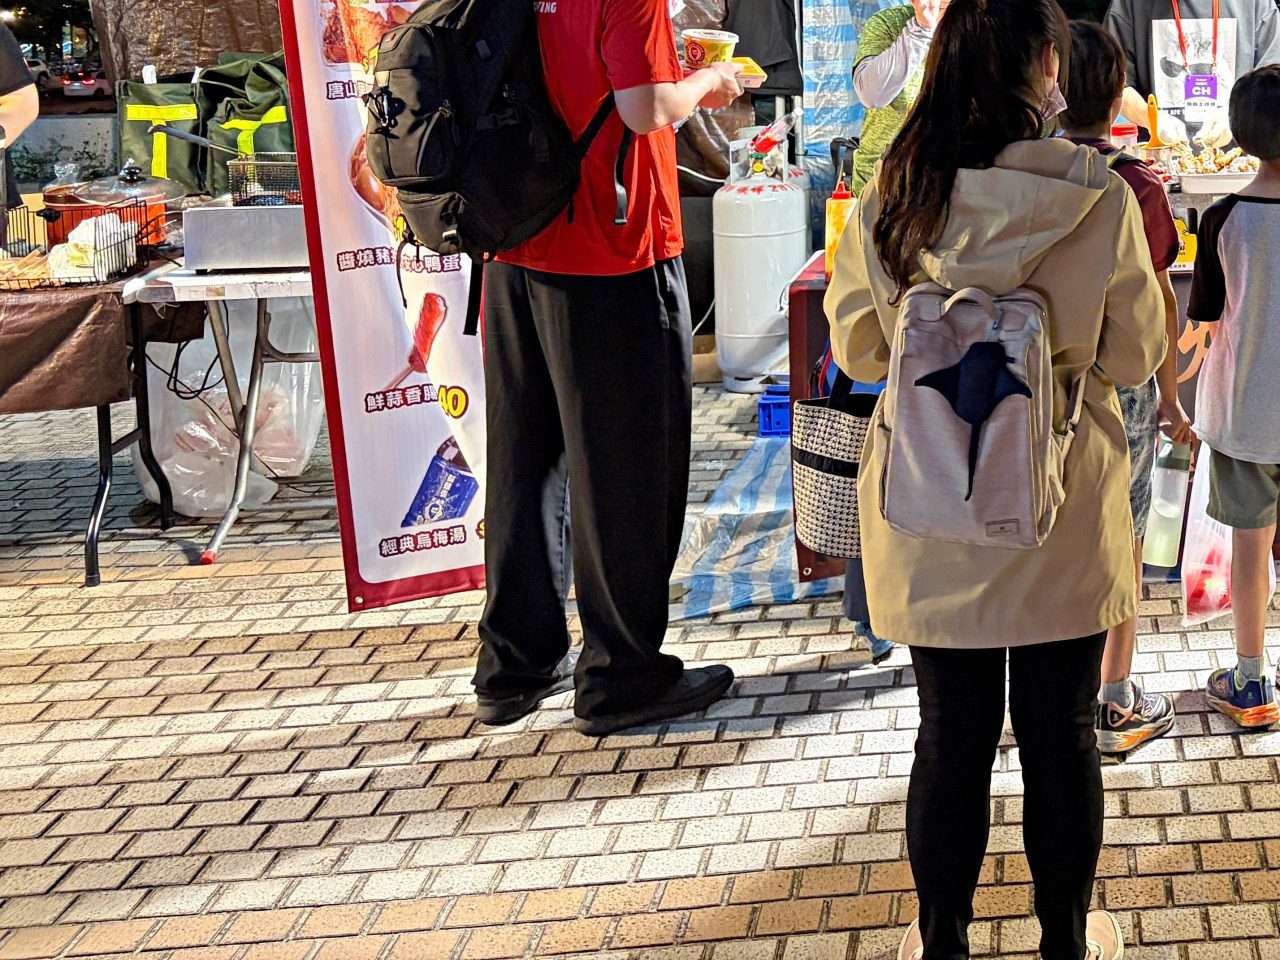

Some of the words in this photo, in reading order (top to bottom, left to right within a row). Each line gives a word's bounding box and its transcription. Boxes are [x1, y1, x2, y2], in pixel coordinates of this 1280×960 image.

[1192, 87, 1211, 95] CH
[379, 524, 467, 558] 經典烏梅湯
